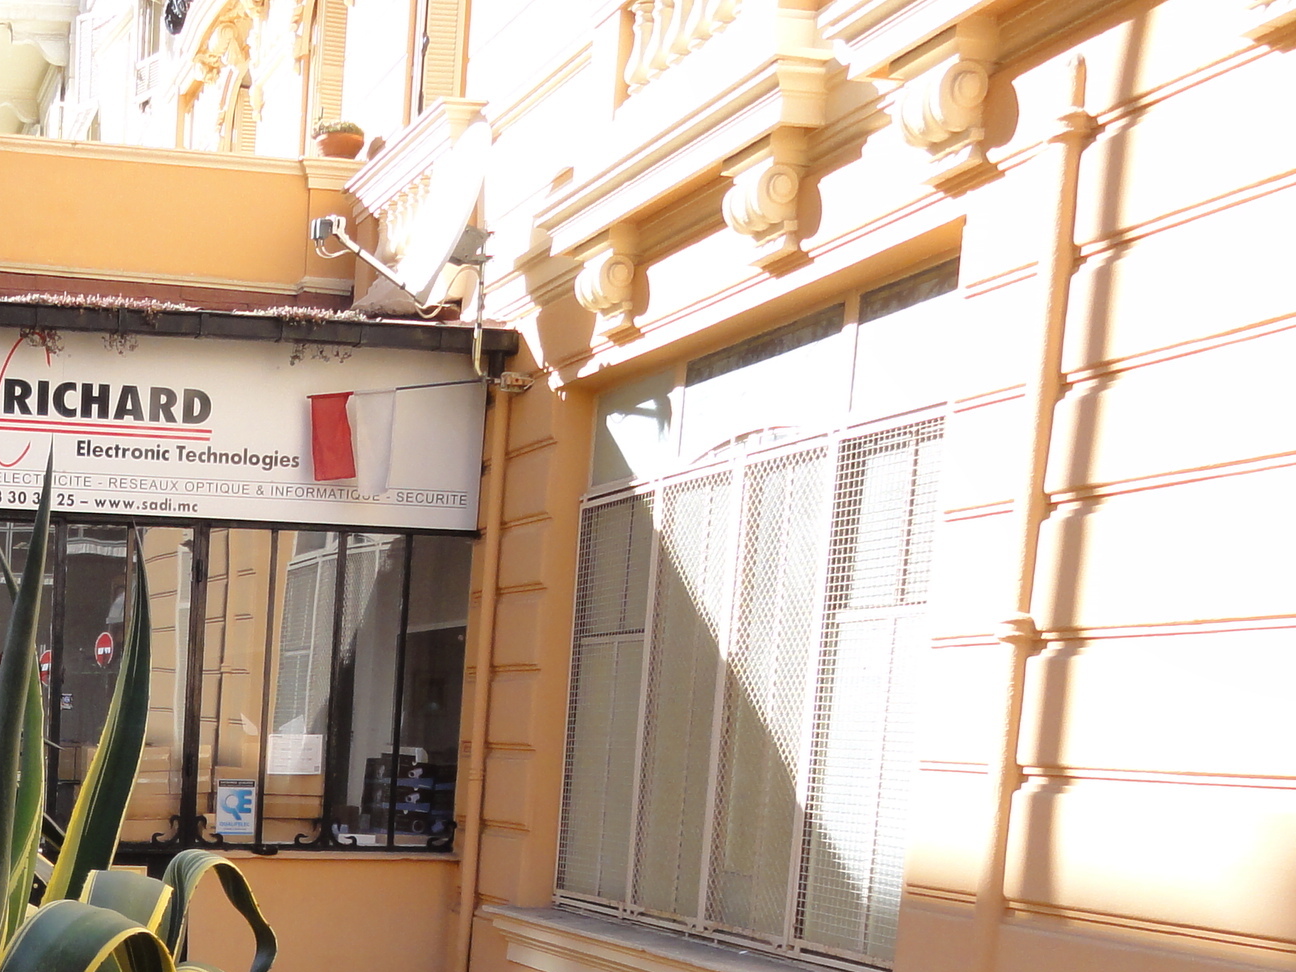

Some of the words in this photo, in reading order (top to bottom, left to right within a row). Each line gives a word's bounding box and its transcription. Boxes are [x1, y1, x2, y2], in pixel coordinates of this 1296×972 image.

[3, 378, 212, 425] RICHARD
[76, 440, 170, 462] Electronic
[176, 445, 300, 471] Technologies
[8, 490, 27, 504] 30
[57, 493, 74, 506] 25
[94, 497, 198, 513] www.sadi.mc
[108, 477, 179, 491] RESEAUX
[184, 481, 250, 495] OPTIQUE
[256, 484, 265, 496] &
[396, 491, 467, 506] SECURITE
